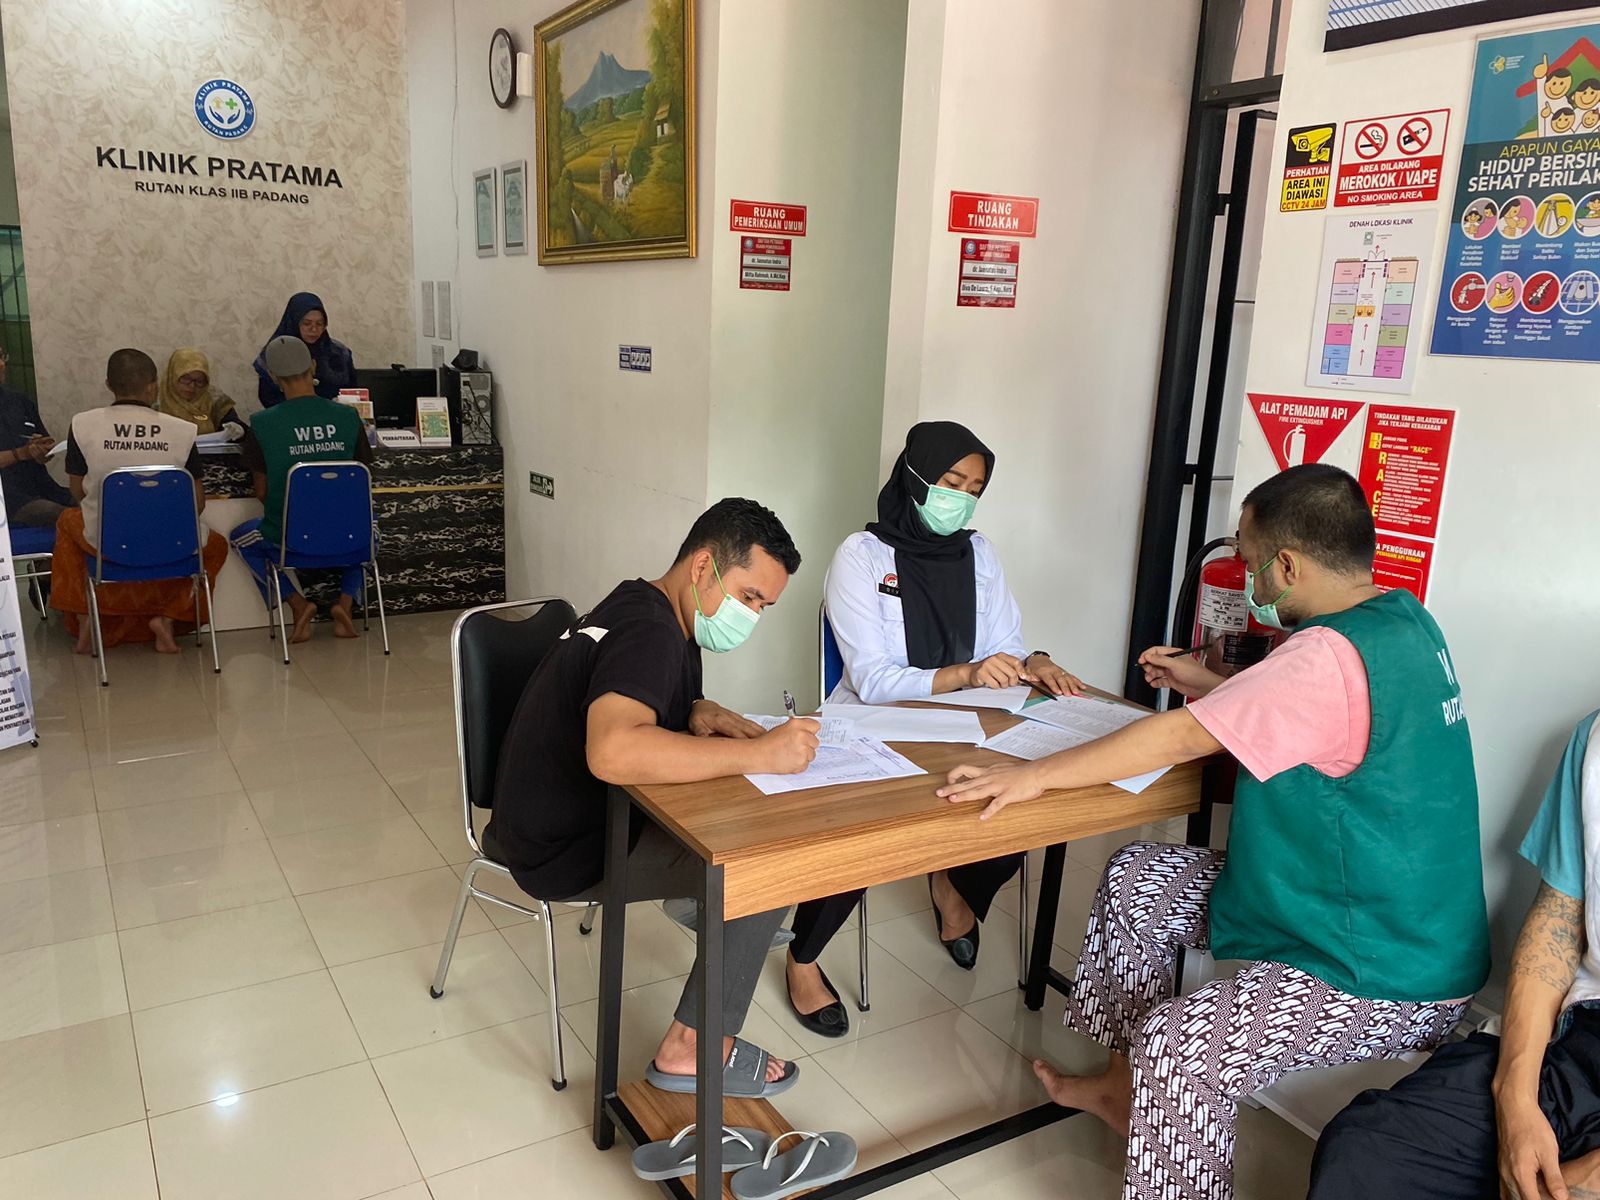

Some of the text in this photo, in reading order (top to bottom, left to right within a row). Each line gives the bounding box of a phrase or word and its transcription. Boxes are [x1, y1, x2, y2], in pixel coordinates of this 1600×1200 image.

[1500, 141, 1558, 158] APAPUN
[96, 146, 343, 188] KLINIK PRATAMA
[1286, 166, 1330, 178] PERHATIAN
[1358, 160, 1420, 174] AREA DILARANG
[1479, 157, 1535, 176] HIDUP
[1286, 177, 1326, 190] AREA INI
[1339, 173, 1397, 191] MEROKOK
[1405, 169, 1438, 185] VAPE
[1467, 174, 1524, 192] SEHAT
[135, 181, 310, 205] RUTAN KLAS IIB PADANG
[1286, 189, 1324, 201] DIAWASI
[1347, 190, 1423, 204] NO SMOKING AREA
[977, 201, 1012, 215] RUANG
[1281, 199, 1326, 210] CCTV 24 JAM
[753, 207, 786, 219] RUANG
[734, 216, 803, 231] PEMERIKSAAN UMUM
[967, 214, 1019, 230] TINDAKAN
[1349, 218, 1413, 228] DENAH LOKASI KLINIK
[1259, 401, 1348, 421] ALAT PEMADAM API
[1374, 412, 1400, 421] TINDAKAN
[1401, 414, 1415, 422] YANG
[1289, 417, 1324, 426] EXTINGUISHER
[104, 440, 169, 452] RUTAN PADANG
[289, 441, 345, 456] RUTAN PADANG
[1378, 451, 1387, 465] R
[1375, 468, 1384, 482] A
[1373, 490, 1381, 504] C
[1371, 504, 1379, 517] E
[1382, 543, 1426, 559] PENGGUNAAN
